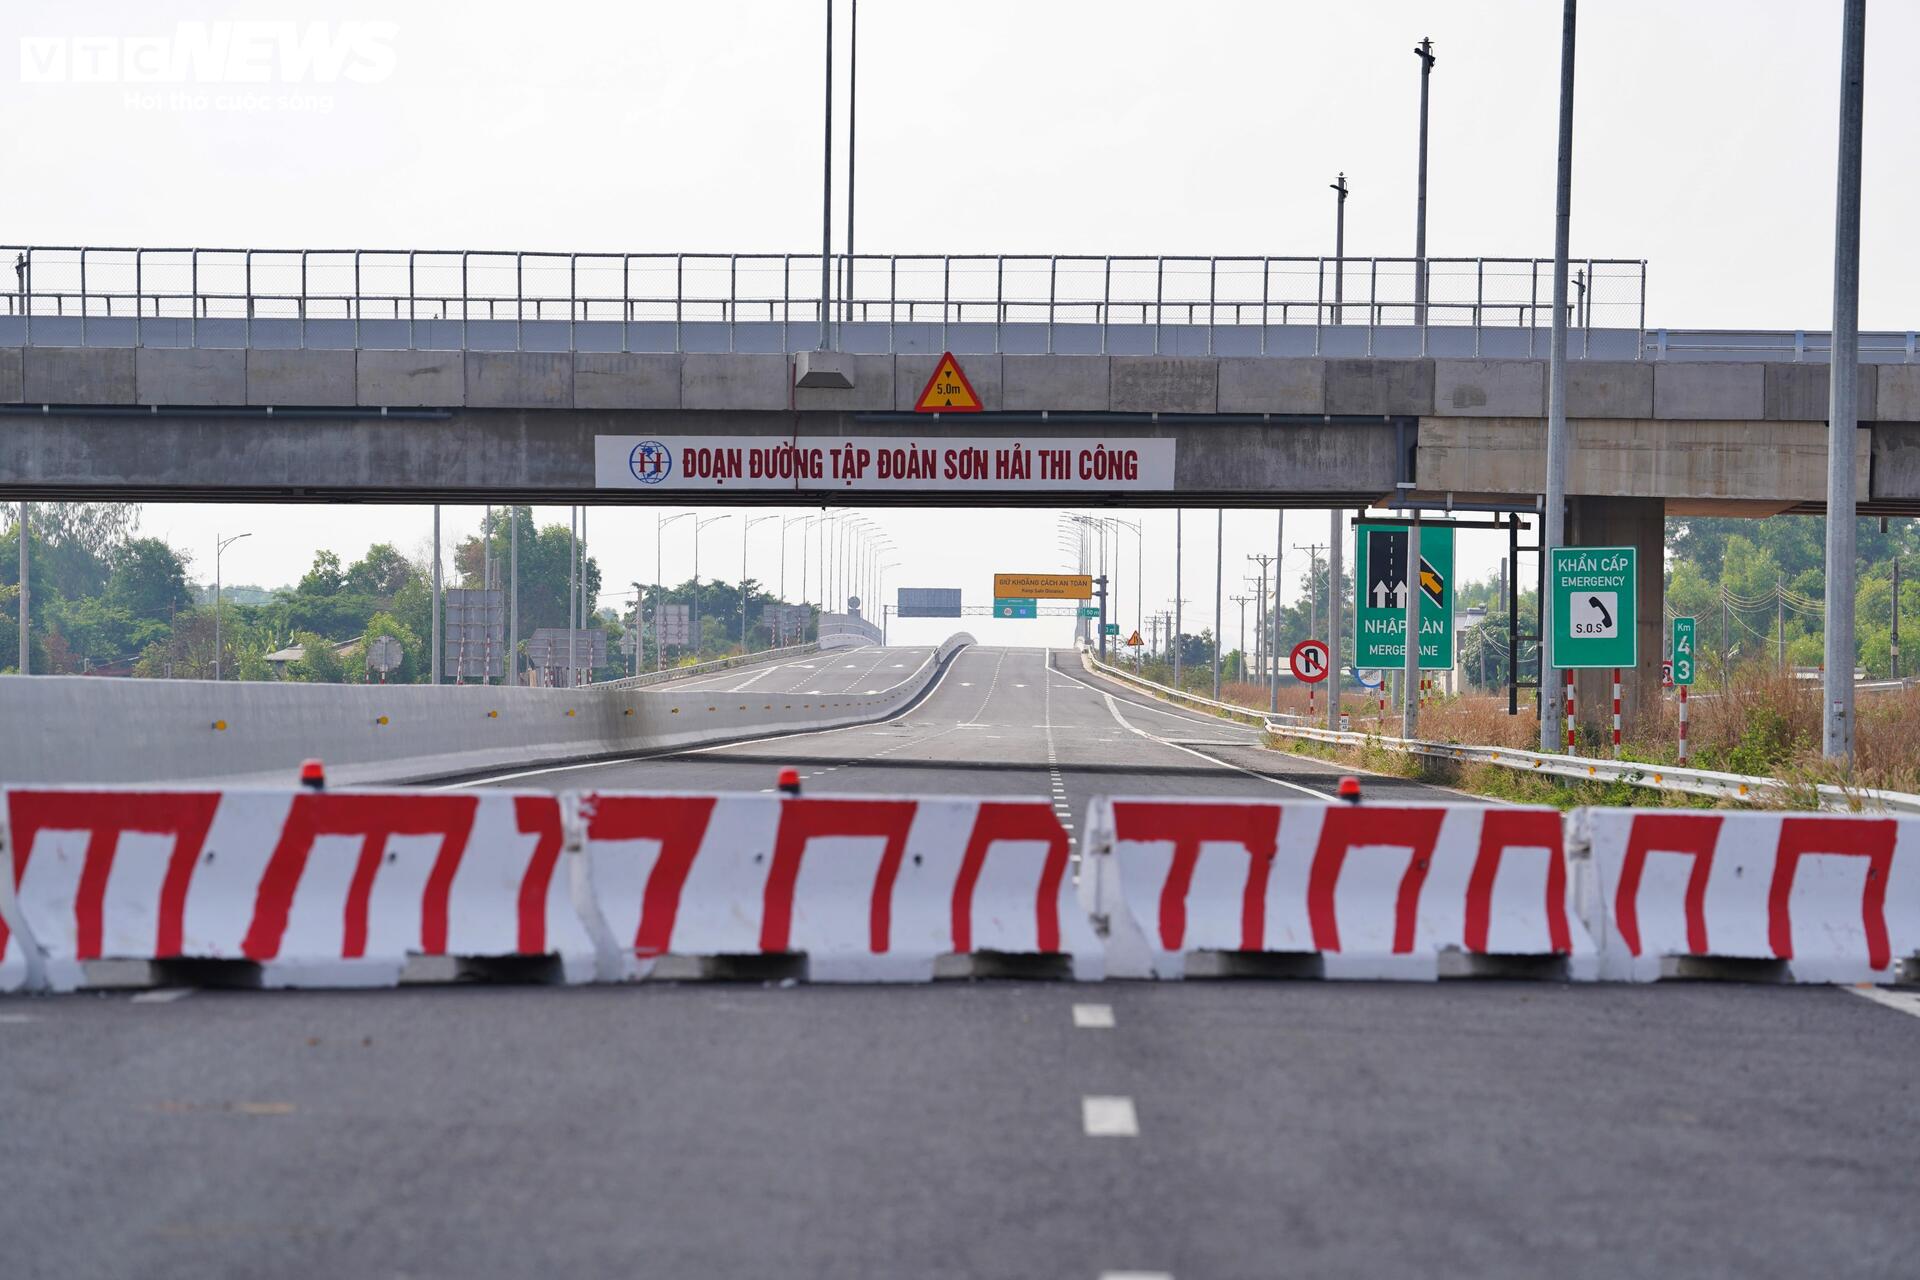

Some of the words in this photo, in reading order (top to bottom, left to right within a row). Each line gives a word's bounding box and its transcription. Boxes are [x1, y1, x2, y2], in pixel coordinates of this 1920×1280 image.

[936, 383, 961, 395] 5.0m
[682, 448, 742, 484] ĐOẠN
[749, 441, 823, 479] ĐƯỜNG
[829, 442, 871, 486] TẬP
[877, 442, 937, 480] ĐOÀN
[944, 446, 988, 480] SƠN
[996, 442, 1031, 480] HẢI
[1038, 449, 1071, 480] THI
[1079, 443, 1138, 481] CÔNG
[1558, 552, 1597, 572] KHẨN
[1601, 553, 1629, 571] CẤP
[1561, 576, 1625, 587] EMERGENCY
[1365, 617, 1407, 636] NHẬP
[1576, 623, 1603, 634] S.O.S
[1677, 623, 1691, 632] Km
[1369, 644, 1406, 655] MERGE
[1678, 635, 1690, 655] 4
[1678, 660, 1690, 680] 3
